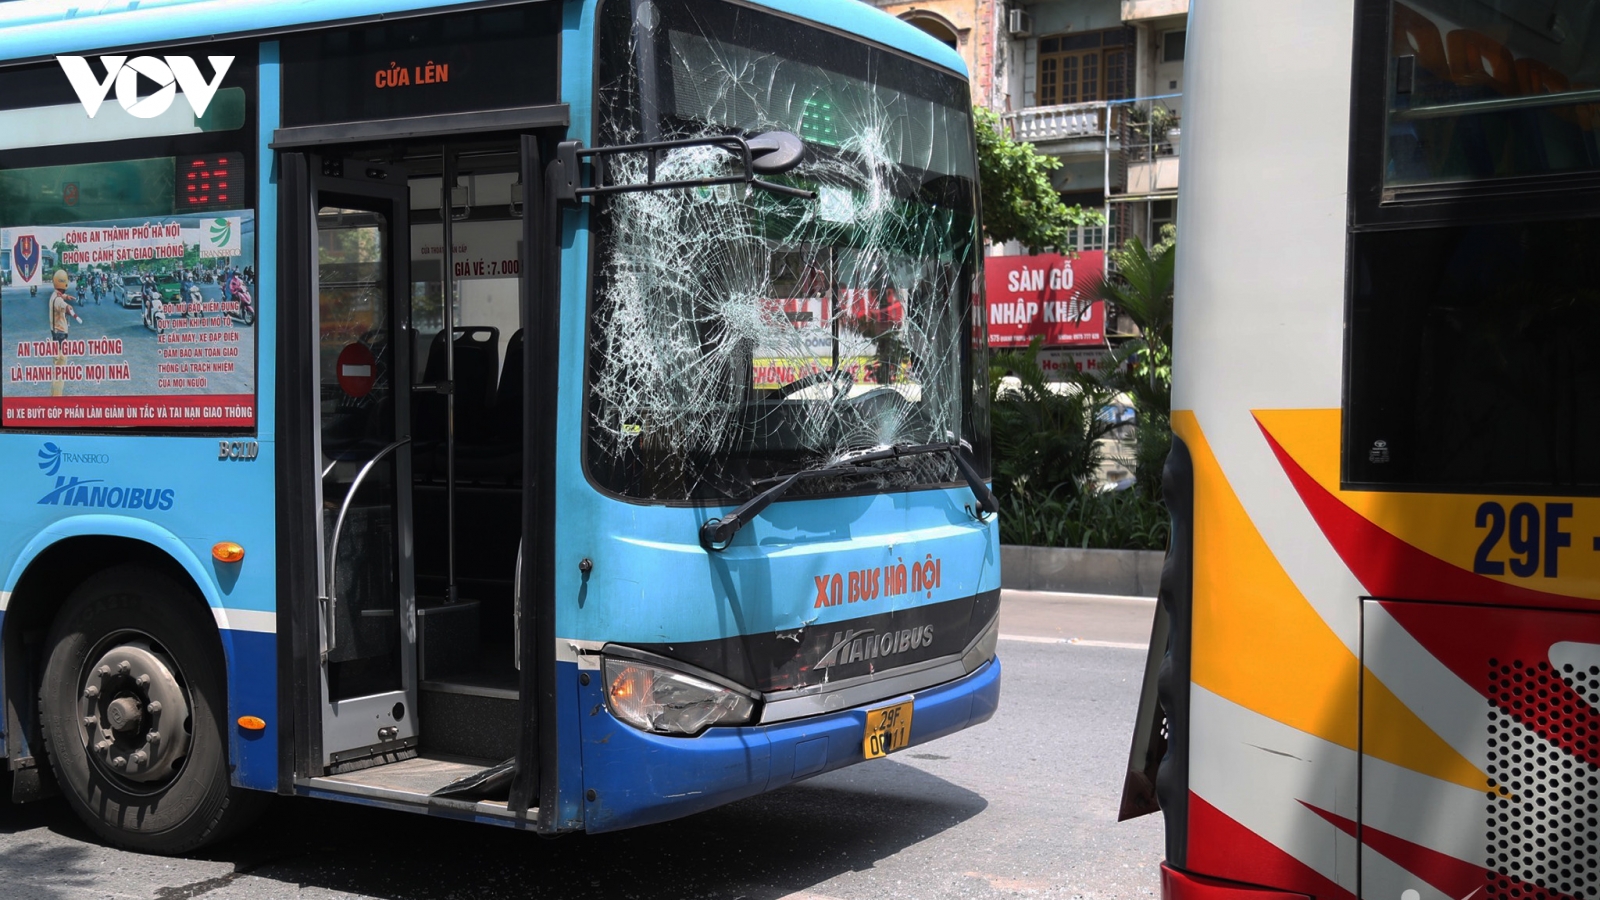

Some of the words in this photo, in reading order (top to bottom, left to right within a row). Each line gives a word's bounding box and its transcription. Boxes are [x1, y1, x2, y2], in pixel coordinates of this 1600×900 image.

[375, 61, 410, 89] CỬA
[415, 60, 449, 86] LÊN
[187, 159, 228, 203] 01
[66, 230, 88, 244] CÔNG
[90, 231, 100, 243] AN
[103, 225, 130, 242] THÀNH
[132, 222, 149, 239] PHỐ
[152, 222, 163, 238] HÀ
[165, 221, 180, 239] NỘI
[92, 247, 114, 262] CẢNH
[116, 246, 131, 260] SÁT
[134, 246, 153, 260] GIAO
[156, 243, 184, 258] THÔNG
[455, 258, 470, 277] GIÁ
[473, 258, 485, 276] VÉ
[1007, 265, 1045, 292] SÀN
[1049, 260, 1074, 290] GỖ
[163, 302, 174, 316] ĐỘI
[990, 298, 1039, 329] NHẬP
[158, 320, 170, 329] QUY
[172, 319, 188, 331] ĐỊNH
[190, 319, 200, 328] KHI
[202, 319, 209, 327] ĐI
[211, 316, 221, 326] MÔ
[17, 342, 30, 357] AN
[33, 338, 59, 356] TOÀN
[61, 341, 85, 355] GIAO
[88, 337, 122, 354] THÔNG
[158, 335, 166, 343] XE
[199, 333, 207, 342] XE
[209, 332, 222, 344] ĐẠP
[224, 330, 239, 343] ĐIỆN
[194, 348, 203, 357] AN
[223, 347, 238, 357] GIAO
[11, 364, 23, 381] LÀ
[25, 367, 52, 384] HẠNH
[55, 362, 82, 381] PHÚC
[85, 366, 105, 384] MỌI
[108, 361, 130, 380] NHÀ
[158, 362, 179, 373] THÔNG
[213, 360, 234, 374] NHIỆM
[158, 376, 171, 388] CỦA
[173, 378, 185, 390] MỌI
[6, 408, 14, 419] ĐI
[16, 408, 25, 419] XE
[27, 405, 46, 419] BUÝT
[47, 405, 62, 419] GÓP
[87, 404, 102, 419] LÀM
[105, 404, 125, 418] GIẢM
[126, 404, 138, 418] ÙN
[139, 403, 155, 418] TẮC
[157, 404, 168, 418] VÀ
[169, 407, 182, 418] TAI
[184, 407, 201, 420] NẠN
[203, 406, 222, 418] GIAO
[225, 403, 253, 418] THÔNG
[63, 452, 109, 464] TRANSERCO
[37, 476, 175, 511] HANOIBUS
[1473, 501, 1574, 578] 29F
[814, 573, 843, 608] XN
[848, 567, 880, 604] BUS
[884, 557, 908, 597] HÀ
[911, 553, 941, 599] NỘI
[813, 624, 934, 670] HANOIBUS
[880, 707, 901, 730] 29F
